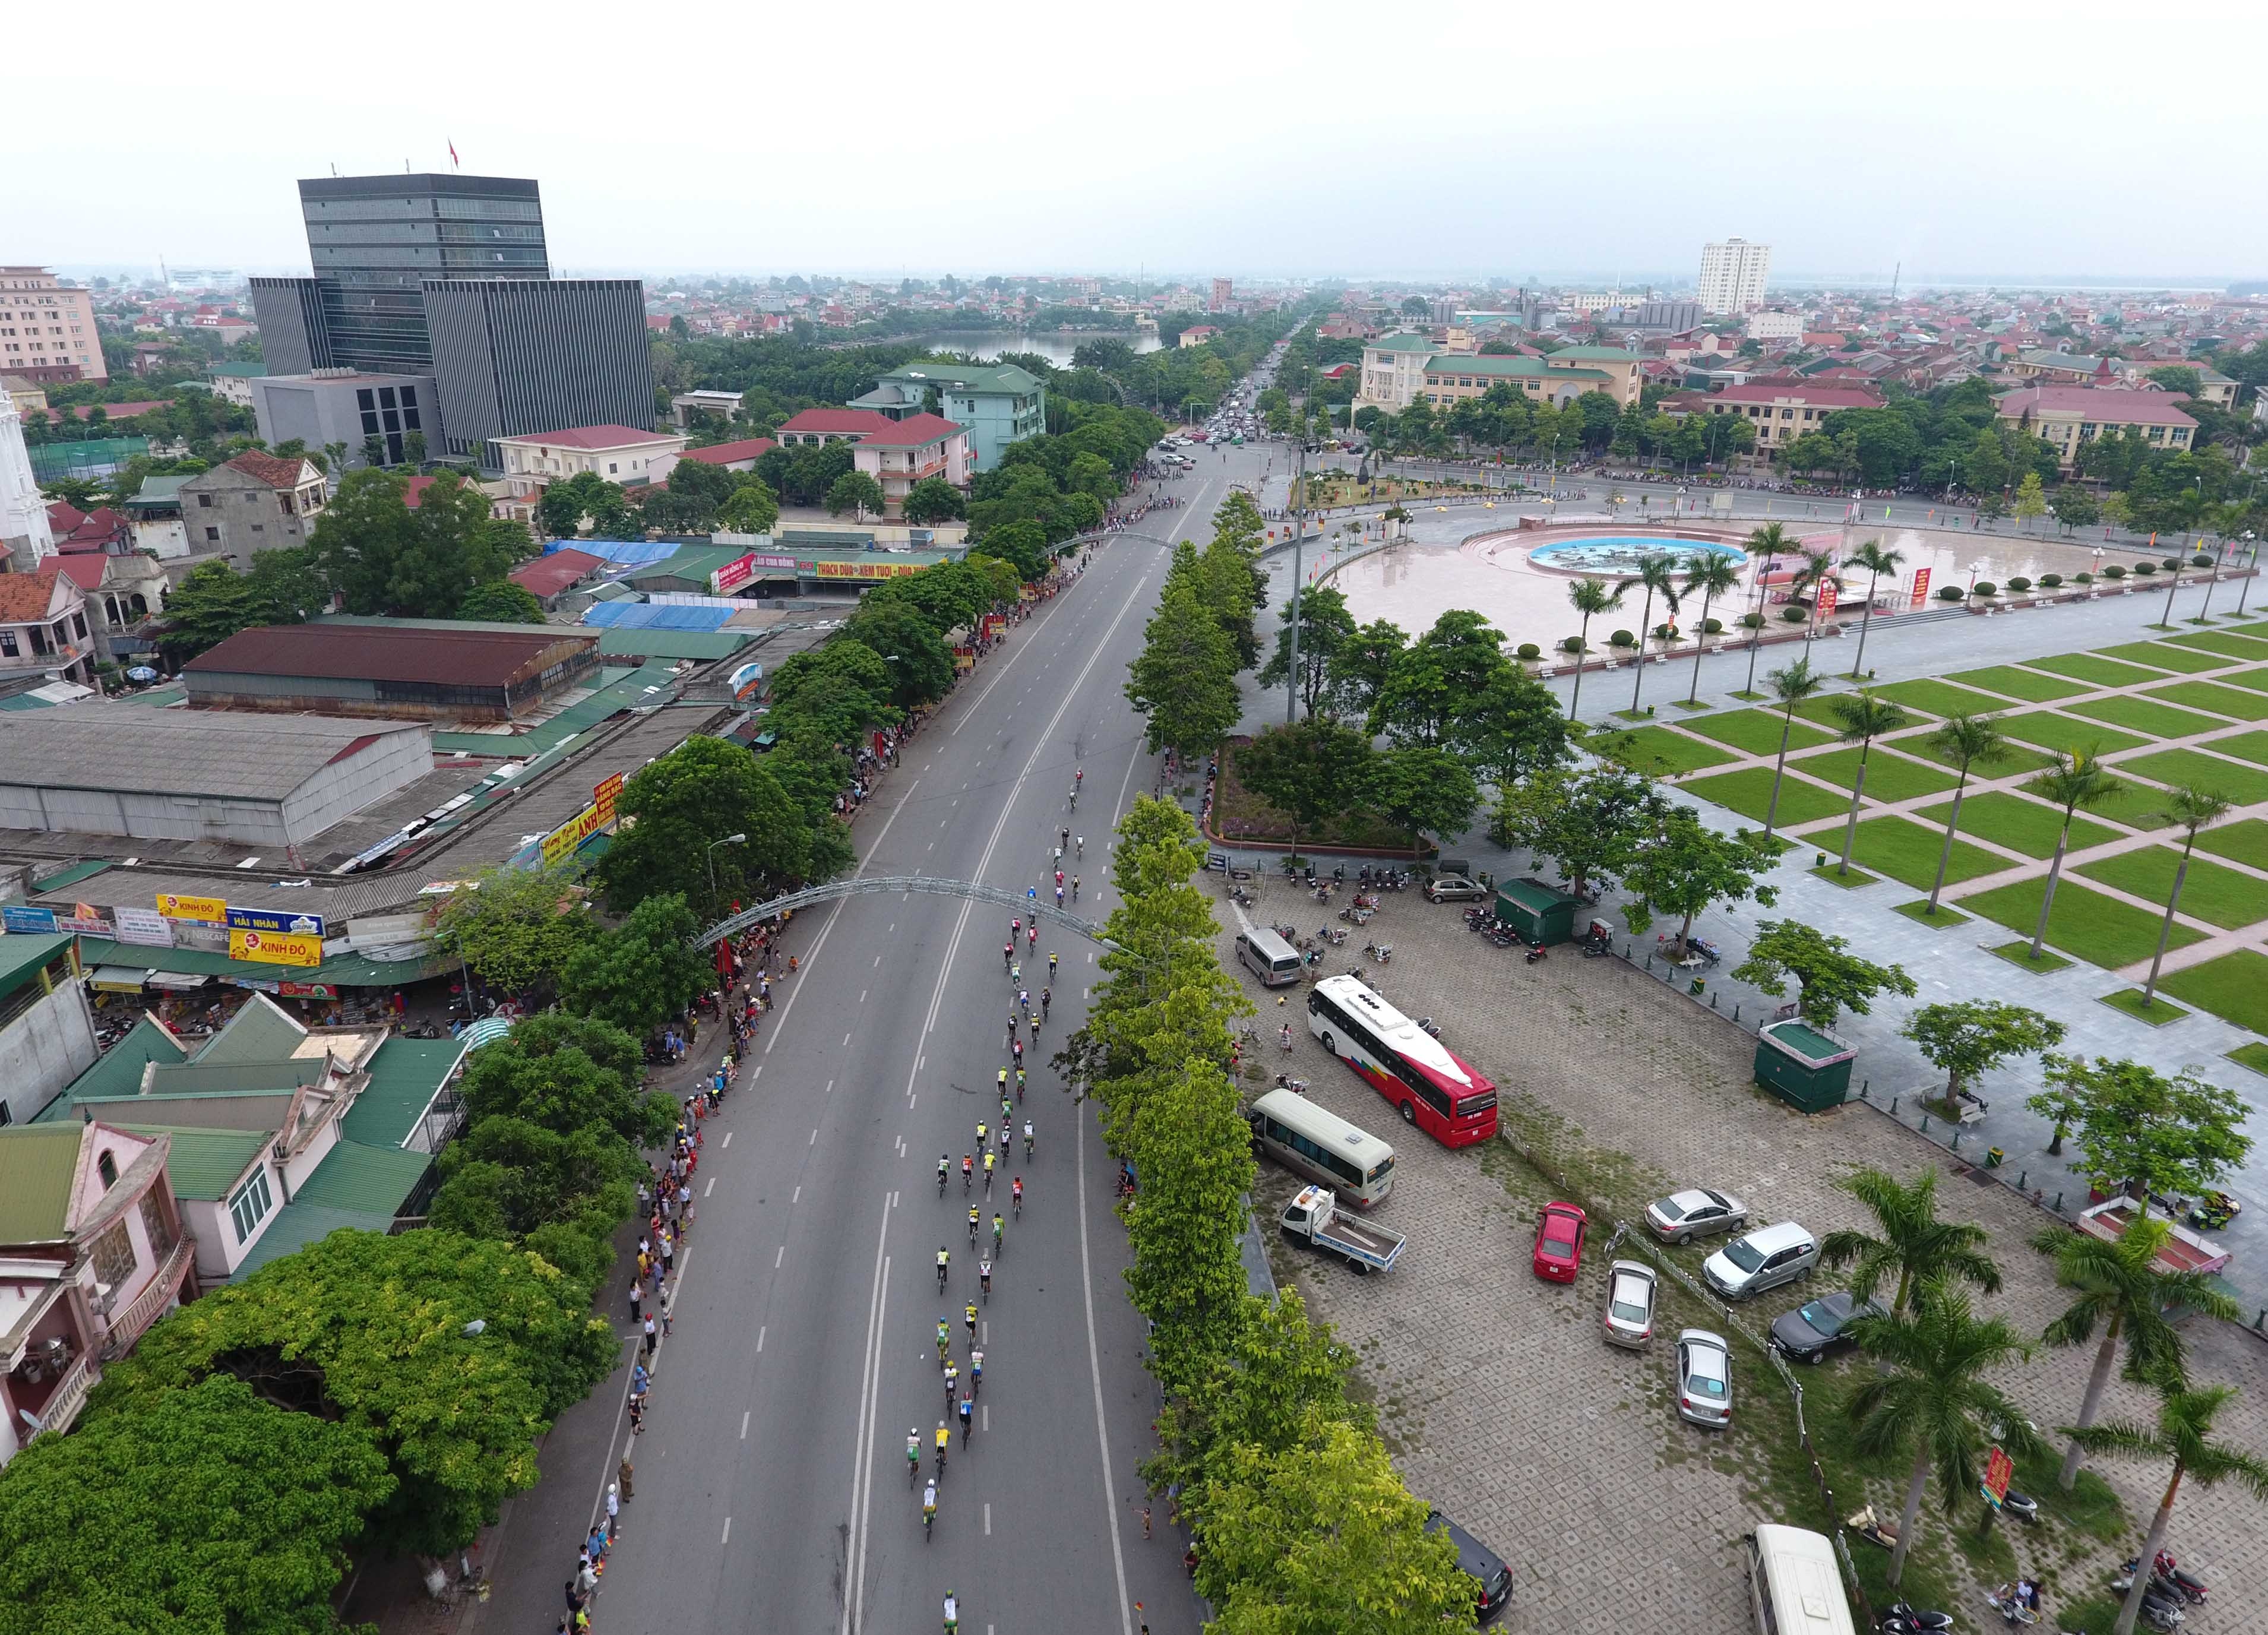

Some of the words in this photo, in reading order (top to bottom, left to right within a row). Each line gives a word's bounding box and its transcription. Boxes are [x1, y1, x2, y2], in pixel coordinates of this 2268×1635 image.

[799, 561, 814, 570] 69
[859, 565, 875, 577] KEM
[180, 902, 200, 911] KINH
[201, 903, 214, 913] ĐÔ
[233, 915, 250, 926] HẢI
[253, 918, 279, 929] NHÀN
[261, 942, 287, 954] KINH
[289, 943, 306, 956] ĐÔ
